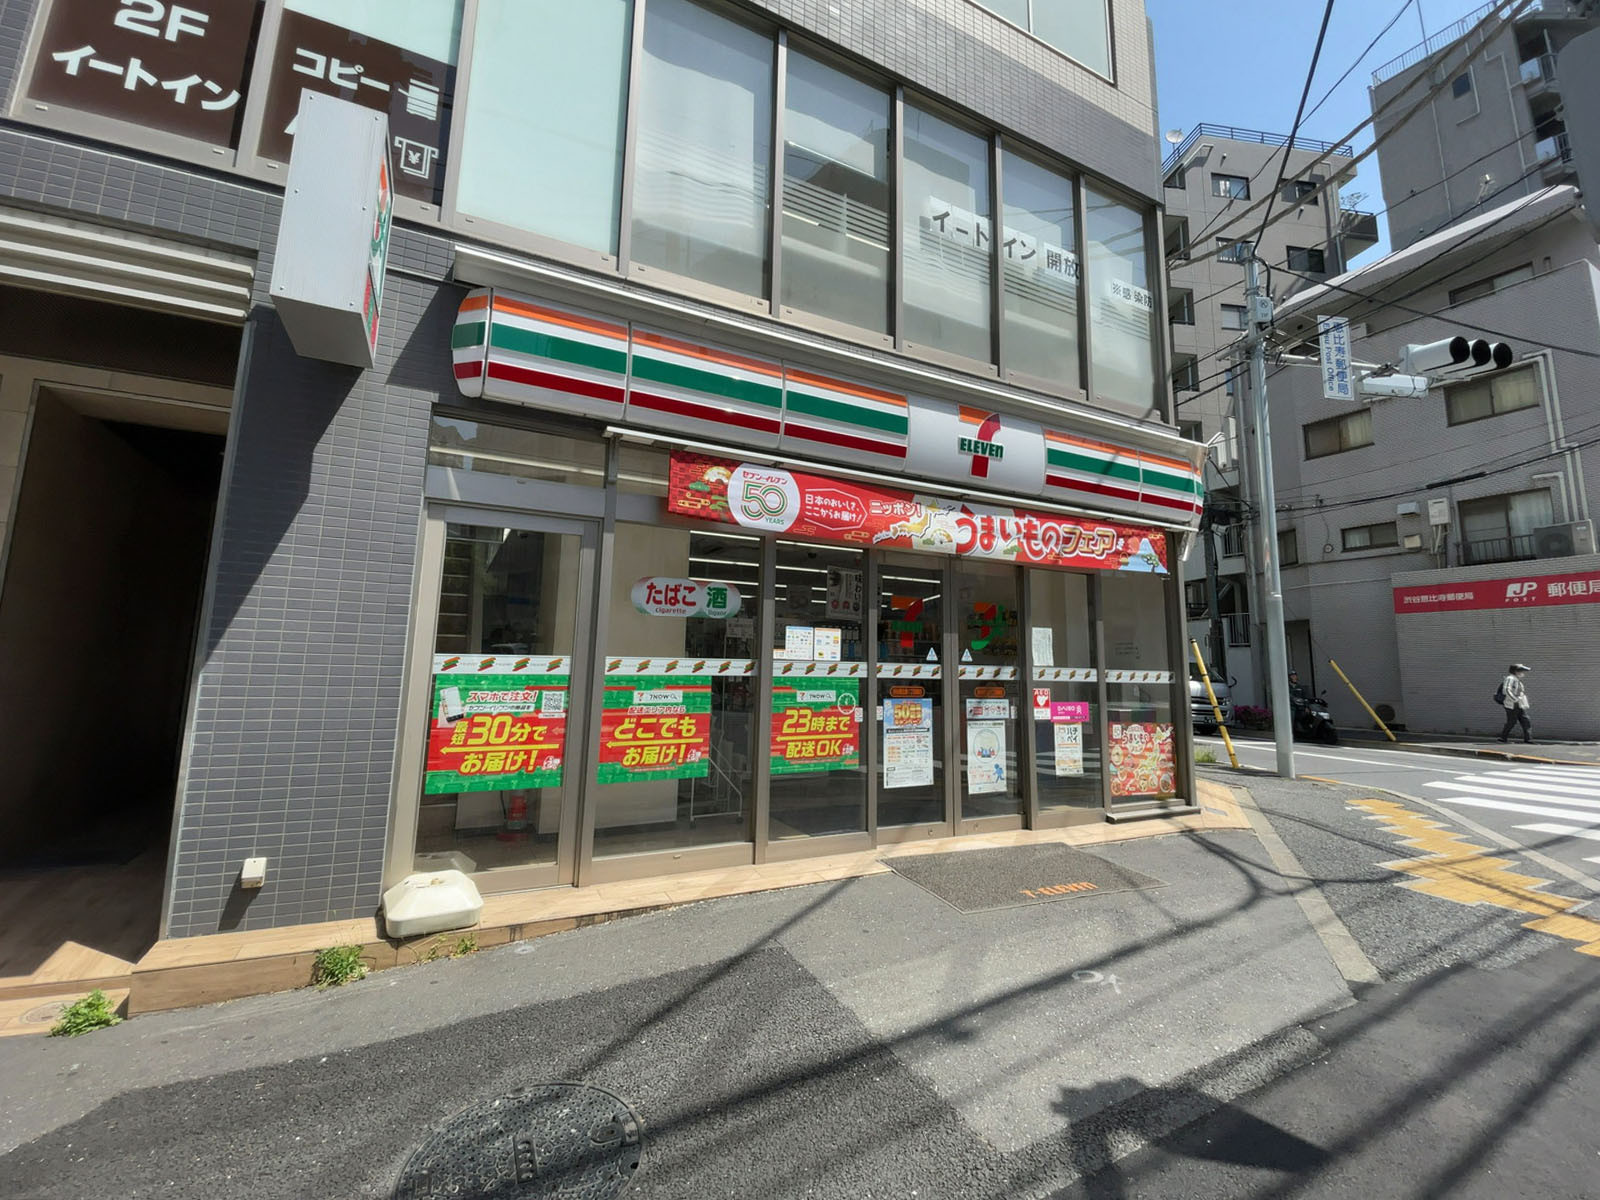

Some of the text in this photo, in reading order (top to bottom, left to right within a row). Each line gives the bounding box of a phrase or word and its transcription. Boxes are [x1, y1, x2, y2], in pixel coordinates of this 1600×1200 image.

[114, 0, 209, 41] 2F
[52, 45, 241, 110] イートイン
[292, 48, 391, 92] コピー
[1046, 249, 1080, 280] 開放
[1323, 322, 1331, 345] Esu
[958, 403, 1001, 478] 7
[741, 480, 788, 521] 50
[869, 501, 923, 517] ニッポン!
[765, 516, 785, 526] YEARS
[646, 582, 728, 609] たばこ 酒
[1547, 579, 1600, 598] 郵便局
[467, 691, 538, 702] スマホで注文!
[467, 715, 547, 745] 30分で
[614, 717, 696, 739] どこでも
[782, 709, 850, 734] 23時まで
[622, 743, 687, 766] お届け!
[785, 740, 842, 758] 配送OK
[460, 750, 538, 773] お届け!
